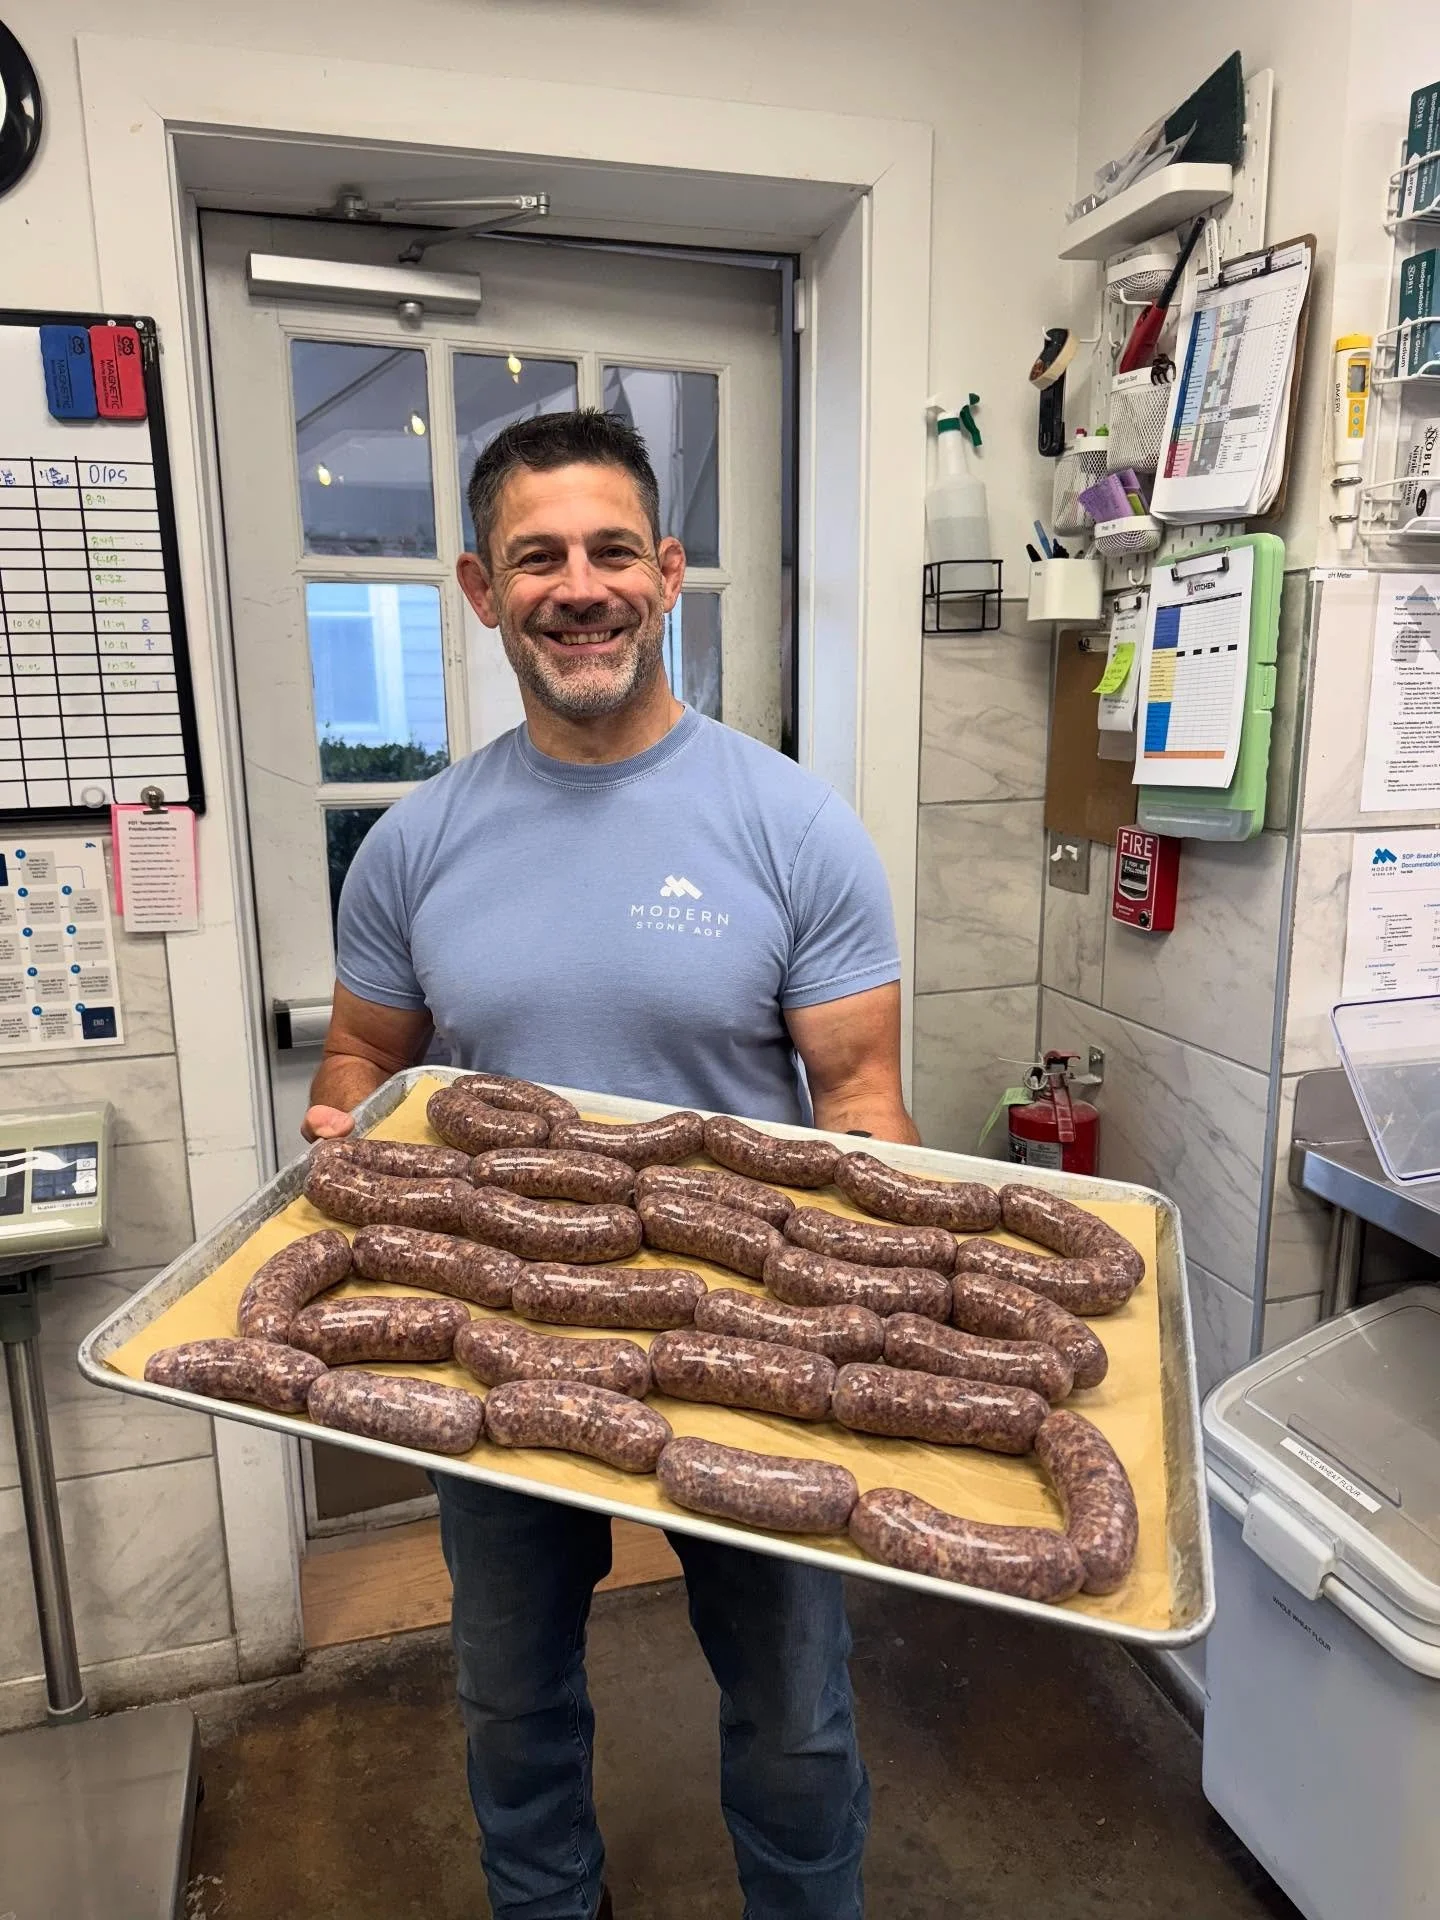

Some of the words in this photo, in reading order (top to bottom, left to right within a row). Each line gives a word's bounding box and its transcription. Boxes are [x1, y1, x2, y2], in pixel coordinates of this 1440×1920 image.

[1418, 261, 1427, 315] Biodegradable
[1400, 333, 1409, 368] Medium
[1413, 340, 1421, 365] Gloves
[105, 360, 120, 409] MAGNETIC
[1411, 446, 1420, 474] Nitrile
[1422, 429, 1436, 476] NOBLE
[1194, 582, 1215, 591] KITCHEN
[1121, 833, 1153, 857] FIRE
[630, 904, 729, 926] MODERN
[636, 921, 685, 932] STONE
[693, 927, 722, 938] AGE
[1298, 1450, 1320, 1467] WHOLE
[1319, 1464, 1341, 1481] WHEAT
[1340, 1479, 1361, 1497] FLOUR
